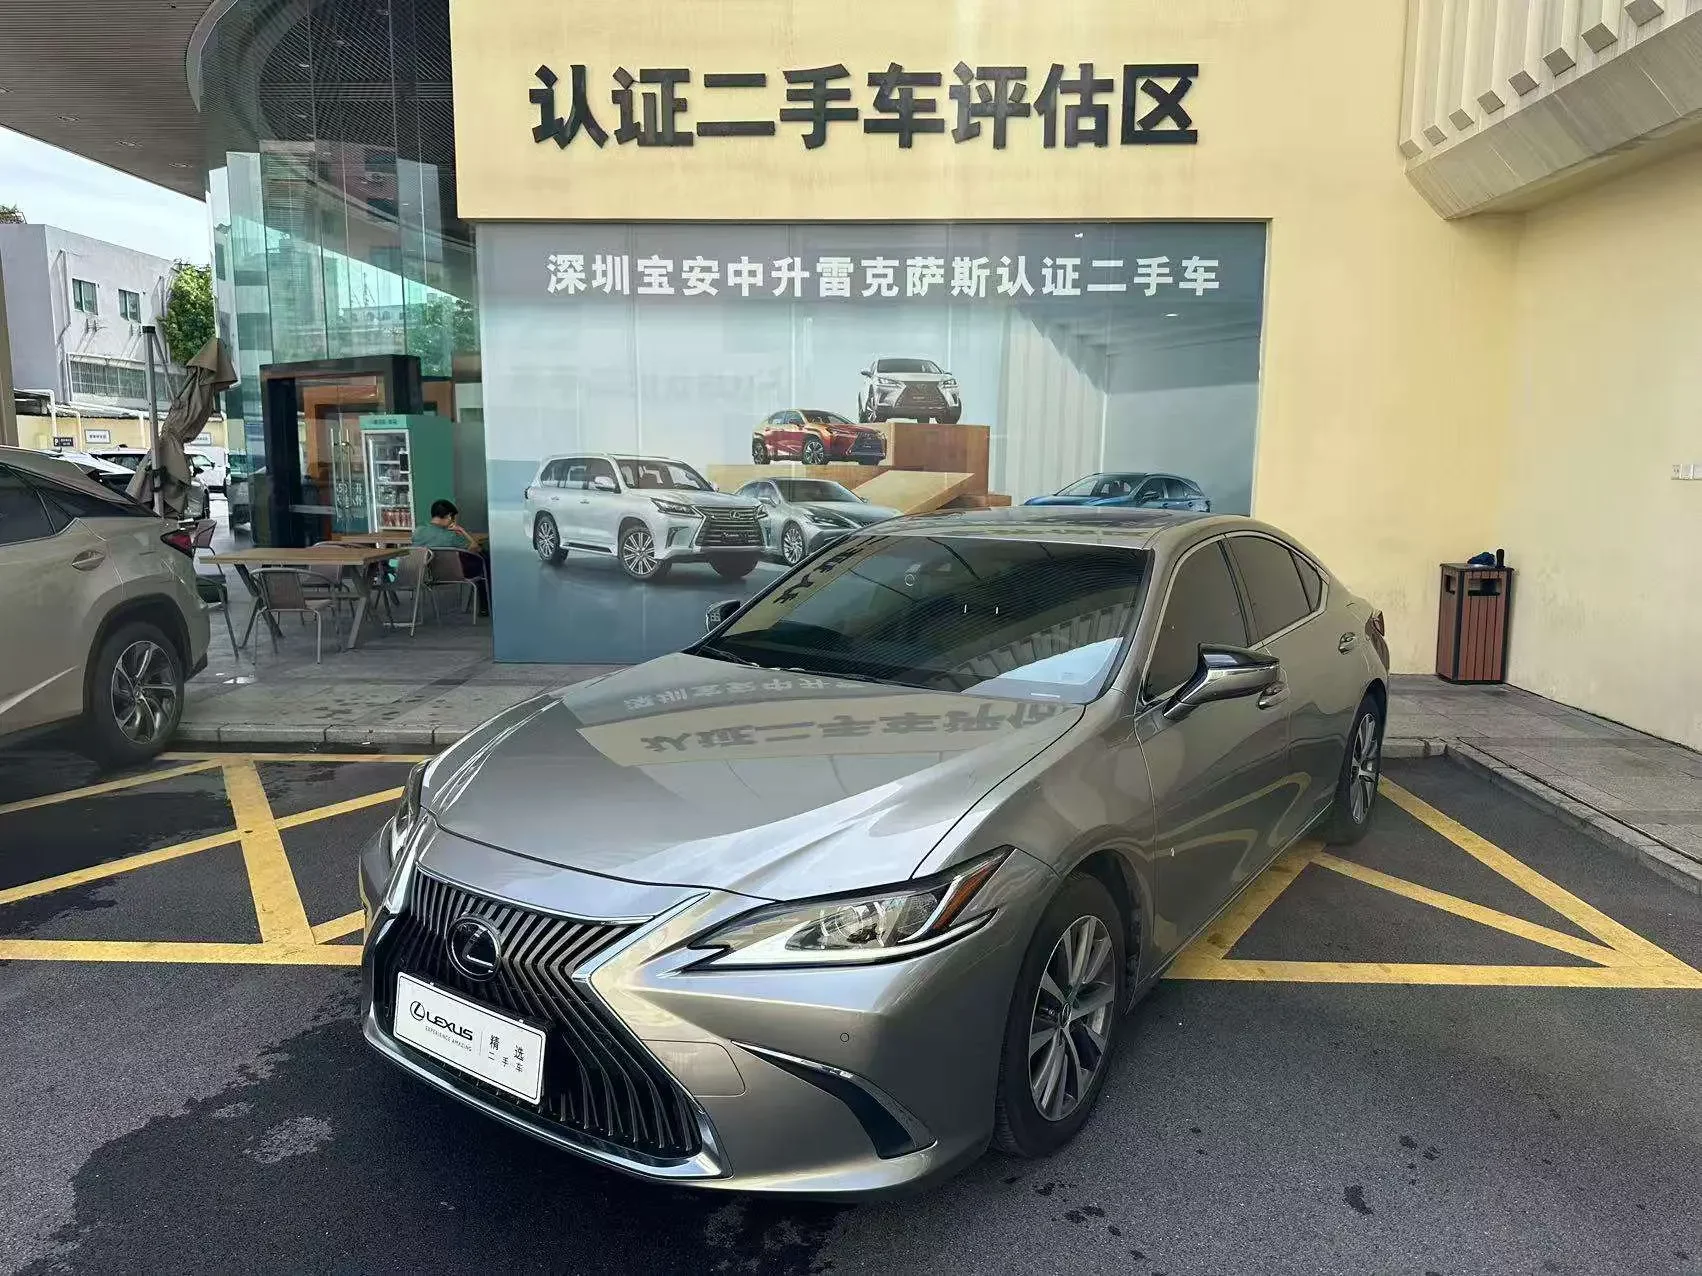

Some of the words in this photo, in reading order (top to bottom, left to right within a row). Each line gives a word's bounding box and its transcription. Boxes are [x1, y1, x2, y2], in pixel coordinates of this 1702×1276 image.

[528, 62, 1200, 149] 认证二手车评估区
[546, 254, 1221, 298] 深圳宝安中升雷克萨斯认证二手车
[427, 1011, 473, 1041] LEXUS
